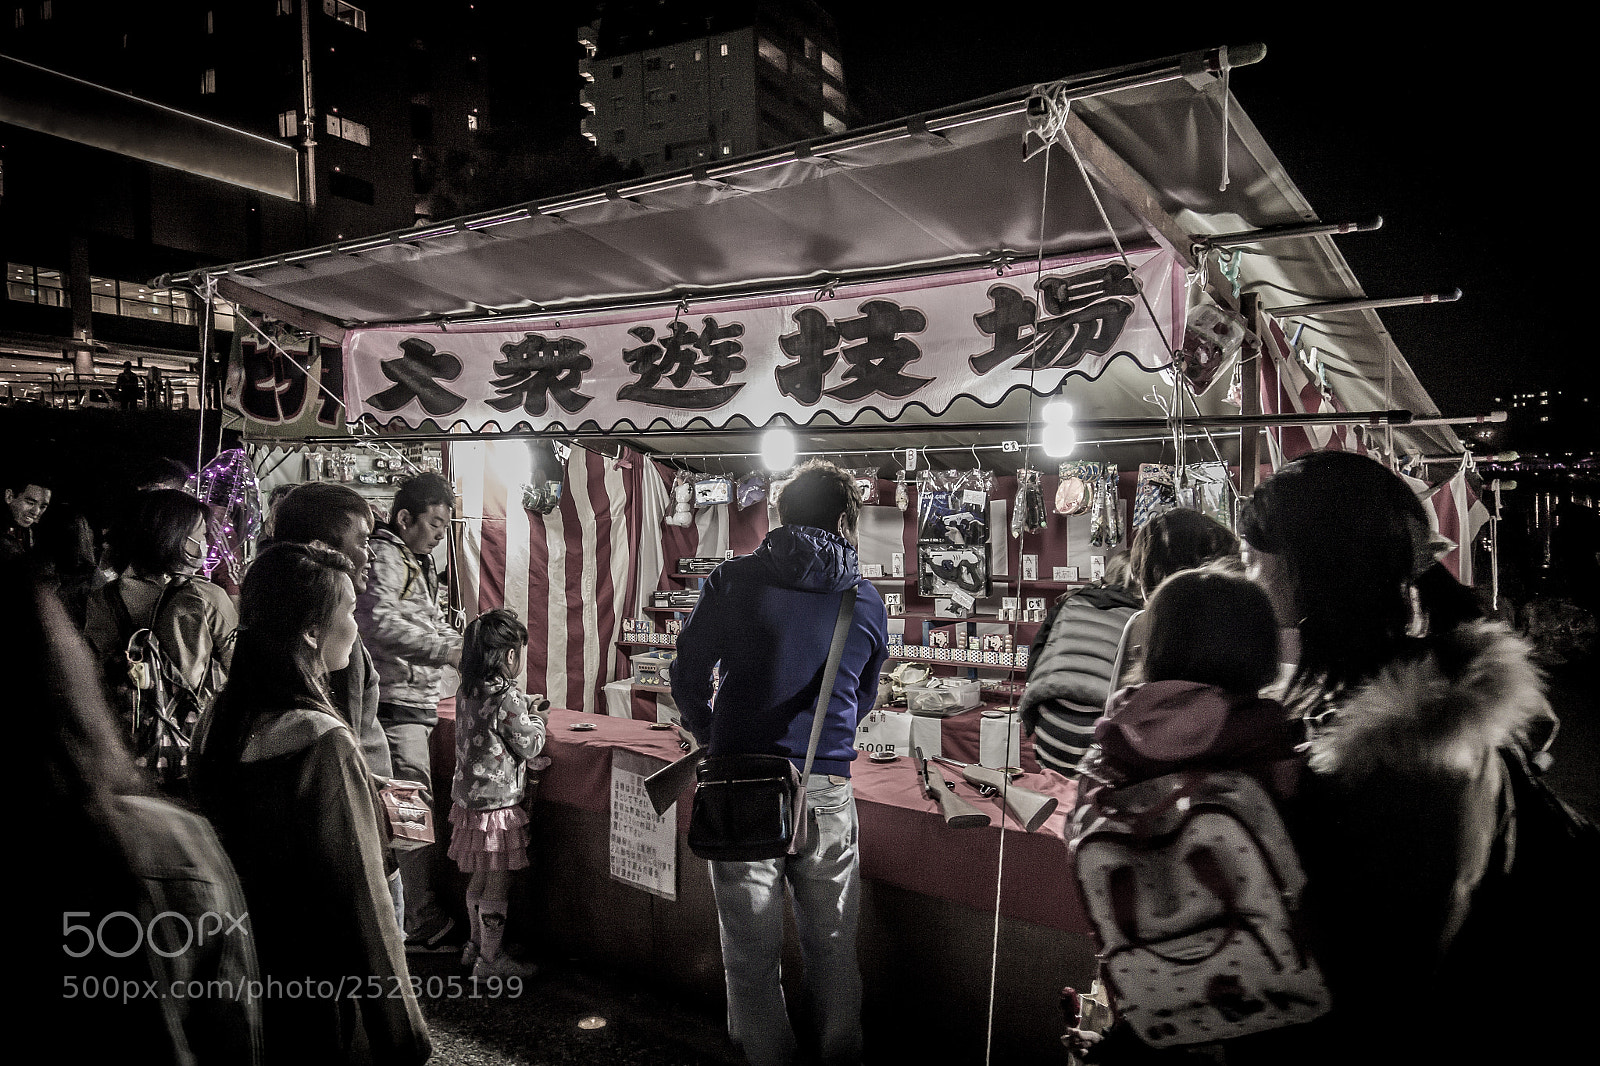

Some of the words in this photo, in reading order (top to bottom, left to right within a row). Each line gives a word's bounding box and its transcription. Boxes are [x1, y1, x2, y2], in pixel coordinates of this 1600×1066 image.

[372, 264, 1144, 416] 大衆遊技場
